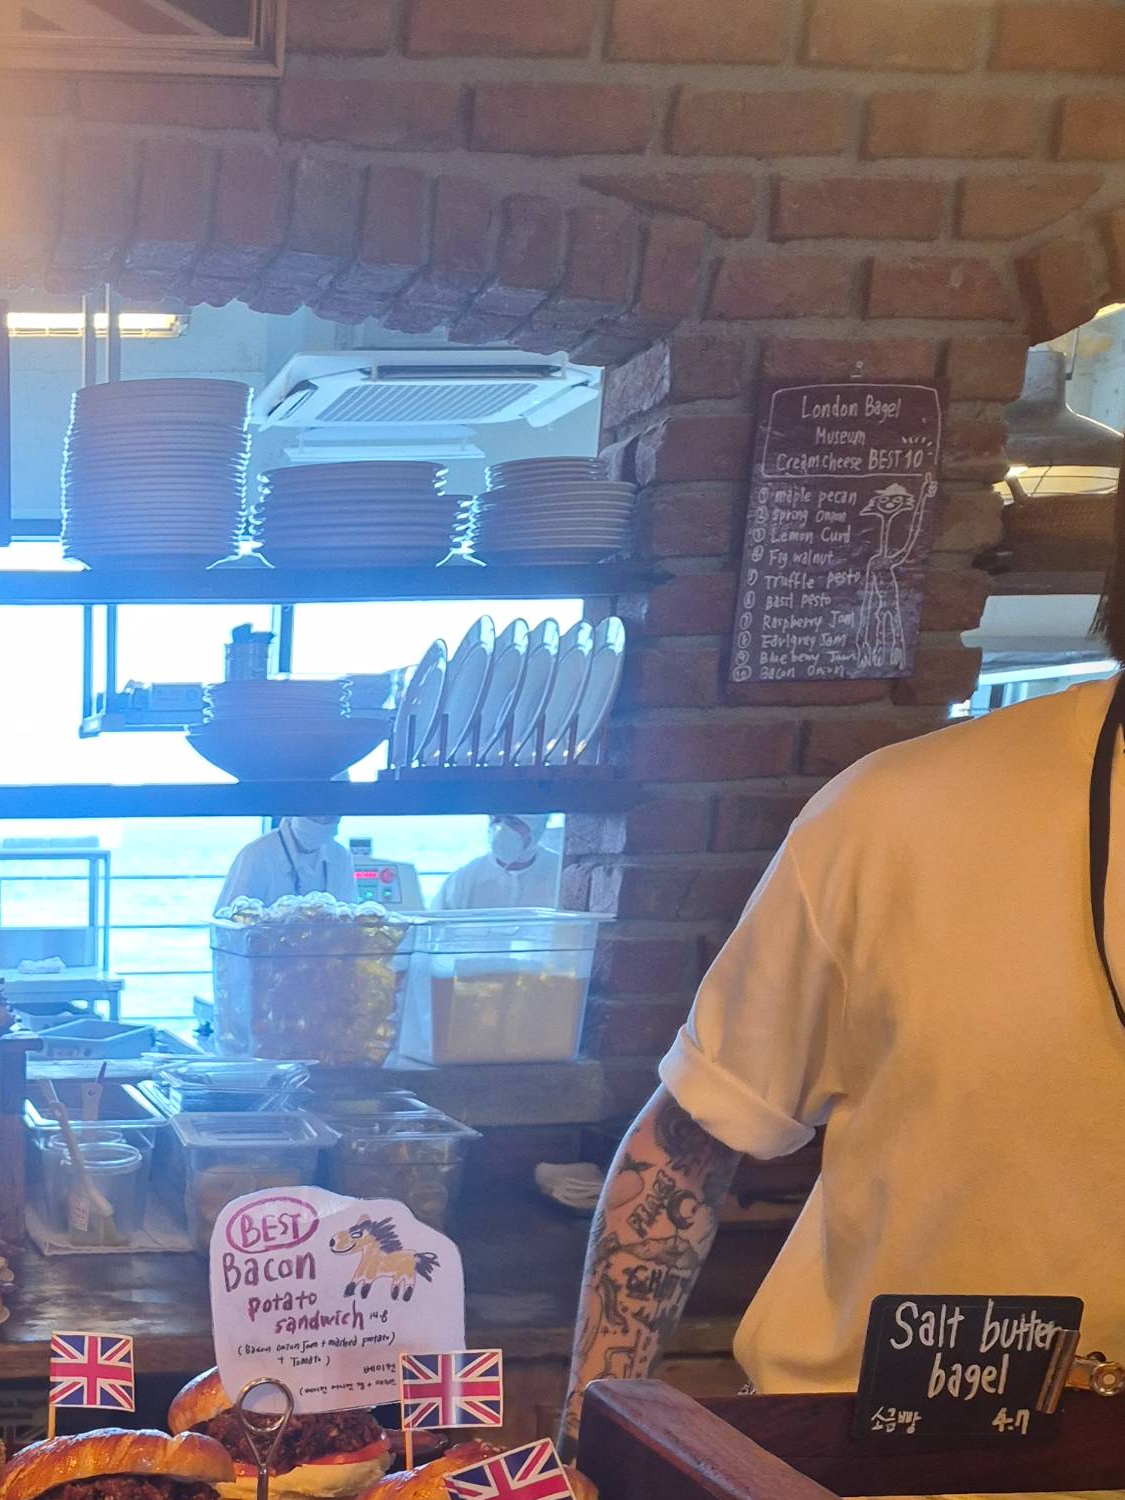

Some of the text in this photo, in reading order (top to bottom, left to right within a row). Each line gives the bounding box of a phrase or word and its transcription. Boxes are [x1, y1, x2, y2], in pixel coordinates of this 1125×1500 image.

[801, 394, 902, 424] London Bagel
[816, 426, 866, 446] Museum
[868, 448, 903, 470] BEST
[904, 449, 924, 468] 10
[819, 491, 858, 508] pecan
[770, 528, 813, 544] Lemon
[821, 525, 851, 543] Curd
[769, 549, 788, 568] Fig
[793, 550, 834, 565] walnut
[764, 571, 815, 590] Truffle
[826, 568, 861, 588] pesto
[763, 614, 823, 633] Raspberry
[241, 1212, 301, 1248] BEST
[222, 1251, 316, 1293] Bacon
[247, 1291, 318, 1322] potato
[275, 1300, 365, 1335] sandwich
[889, 1298, 1062, 1353] Salt butter
[927, 1352, 1010, 1401] bagel
[870, 1406, 923, 1434] 소금빵
